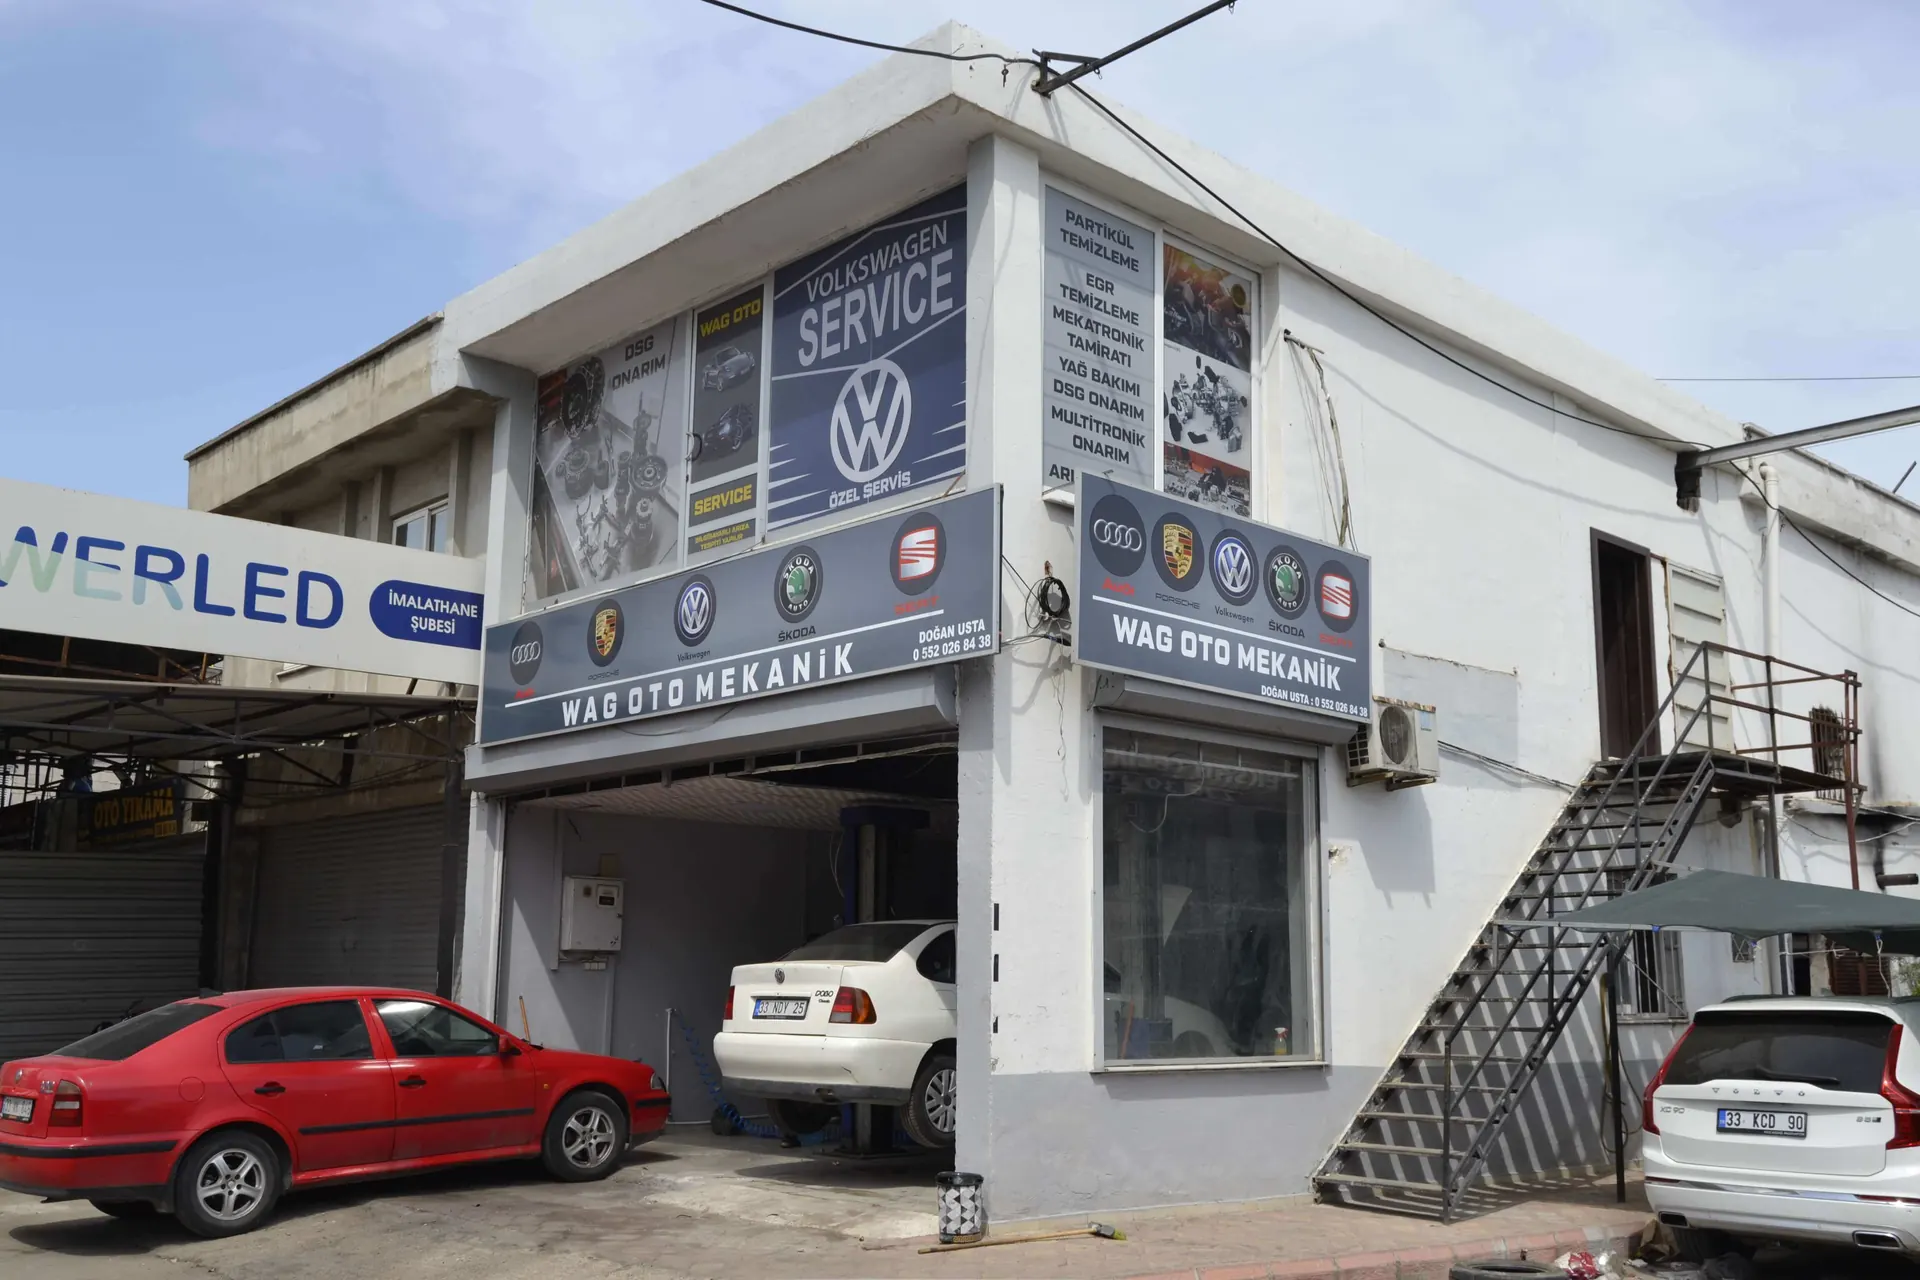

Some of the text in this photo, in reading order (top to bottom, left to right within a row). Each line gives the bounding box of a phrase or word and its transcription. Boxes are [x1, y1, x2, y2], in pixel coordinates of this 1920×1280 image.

[1066, 209, 1134, 250] PARTİKÜL
[806, 219, 947, 302] VOLKSWAGEN
[1060, 228, 1139, 273] TEMİZLEME
[1086, 273, 1114, 296] EGR
[700, 298, 761, 338] WAG OTO
[798, 248, 953, 367] SERVICE
[1060, 283, 1139, 326] TEMİZLEME
[1053, 305, 1144, 352] MEKATRONİK
[625, 335, 654, 362] DSG
[1067, 332, 1131, 367] TAMİRATI
[612, 354, 666, 389] ONARIM
[1059, 356, 1140, 397] YAĞ BAKIMI
[1053, 379, 1144, 421] DSG ONARIM
[1051, 405, 1145, 448] MULTİTRONİK
[1073, 434, 1129, 464] ONARIM
[694, 484, 752, 516] SERVICE
[829, 483, 861, 509] ÖZEL
[389, 588, 478, 619] İMALATHANE
[788, 600, 808, 611] AUTO
[1155, 592, 1200, 611] PORSCHE
[1214, 605, 1254, 624] Volkswagen
[1277, 597, 1298, 609] AUTO
[411, 615, 456, 635] ŞUBESİ
[778, 626, 816, 642] ŠKODA
[919, 618, 986, 644] DOĞAN USTA
[1268, 620, 1305, 640] ŠKODA
[677, 650, 710, 662] Volkswagen
[913, 634, 991, 661] 0 552 026 84 38
[1113, 614, 1341, 692] WAG OTO MEKANİK
[562, 692, 617, 727] WAG
[628, 678, 684, 715] OTO
[1261, 685, 1288, 701] DOĞAN
[1290, 691, 1309, 705] USTA
[1315, 697, 1320, 707] 0
[1321, 698, 1334, 710] 552
[1335, 702, 1348, 713] 026
[1349, 705, 1358, 715] 84
[1359, 706, 1368, 717] 38
[94, 798, 119, 830] OTO
[758, 1001, 806, 1015] 33 NDY 25
[1726, 1112, 1804, 1130] 33 KCD 90
